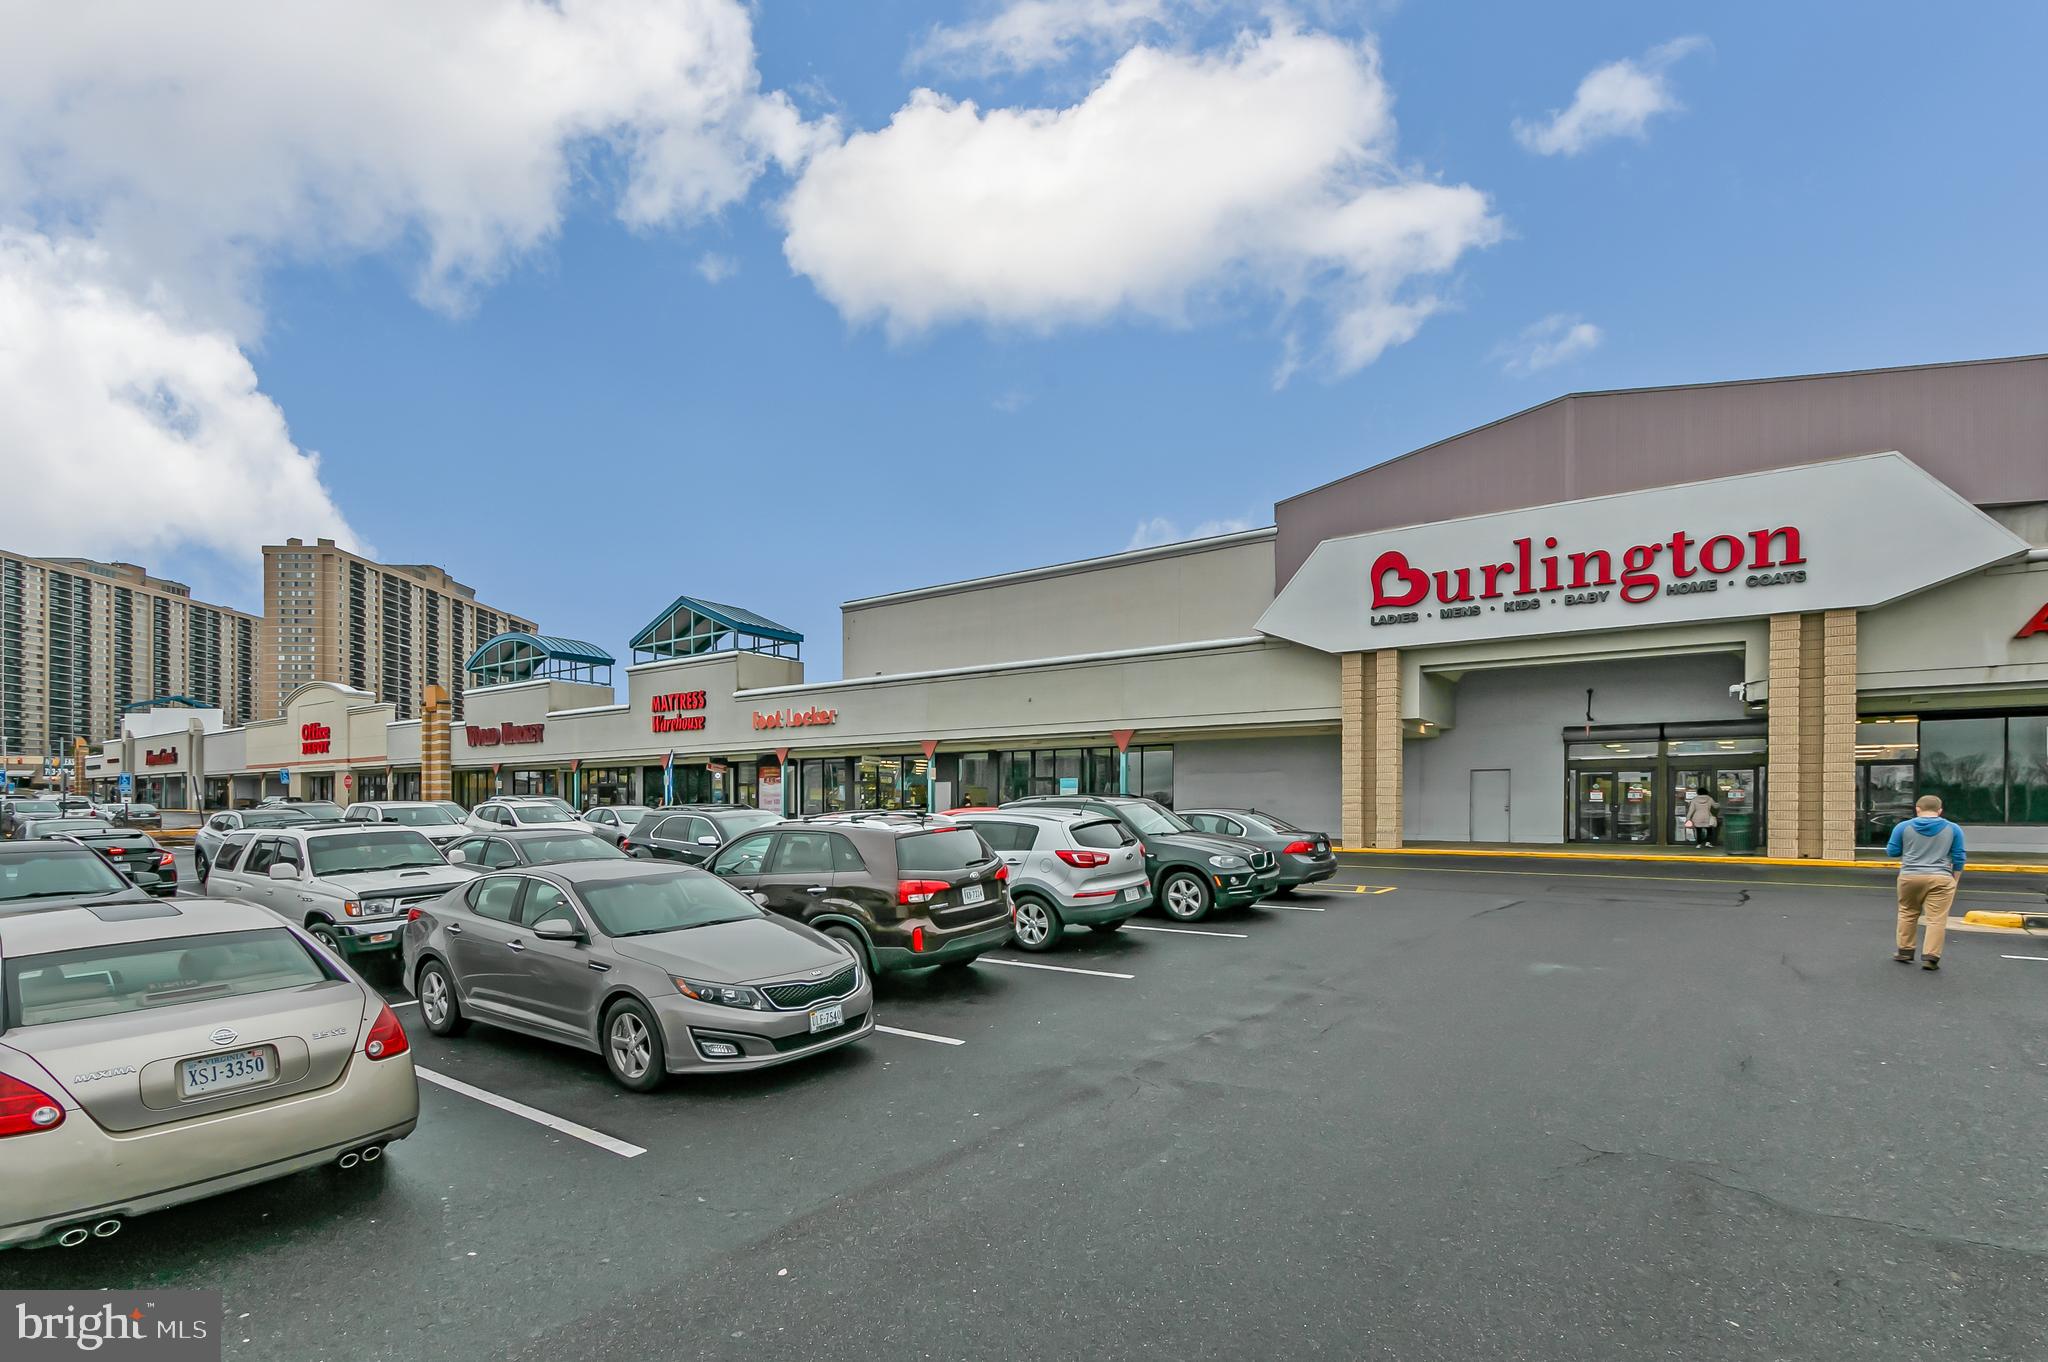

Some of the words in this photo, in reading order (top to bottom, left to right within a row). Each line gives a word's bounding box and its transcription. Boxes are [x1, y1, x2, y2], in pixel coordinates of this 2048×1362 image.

[1371, 526, 1807, 610] Burlington
[1370, 612, 1419, 627] LADIES
[1440, 605, 1481, 619] MENS
[1504, 598, 1540, 613] KIDS
[1564, 590, 1610, 606] BABY
[1666, 579, 1718, 596] HOME
[1745, 570, 1807, 588] COATS
[651, 690, 706, 713] MATTRESS
[651, 713, 706, 733] Warehouse
[752, 710, 784, 730] Foot
[786, 706, 838, 727] Locker
[302, 722, 330, 741] Office
[302, 740, 330, 755] DEPOT
[204, 1052, 246, 1065] VIRGINIA
[74, 1065, 137, 1083] MAXIMA
[188, 1057, 264, 1086] XSJ-3350
